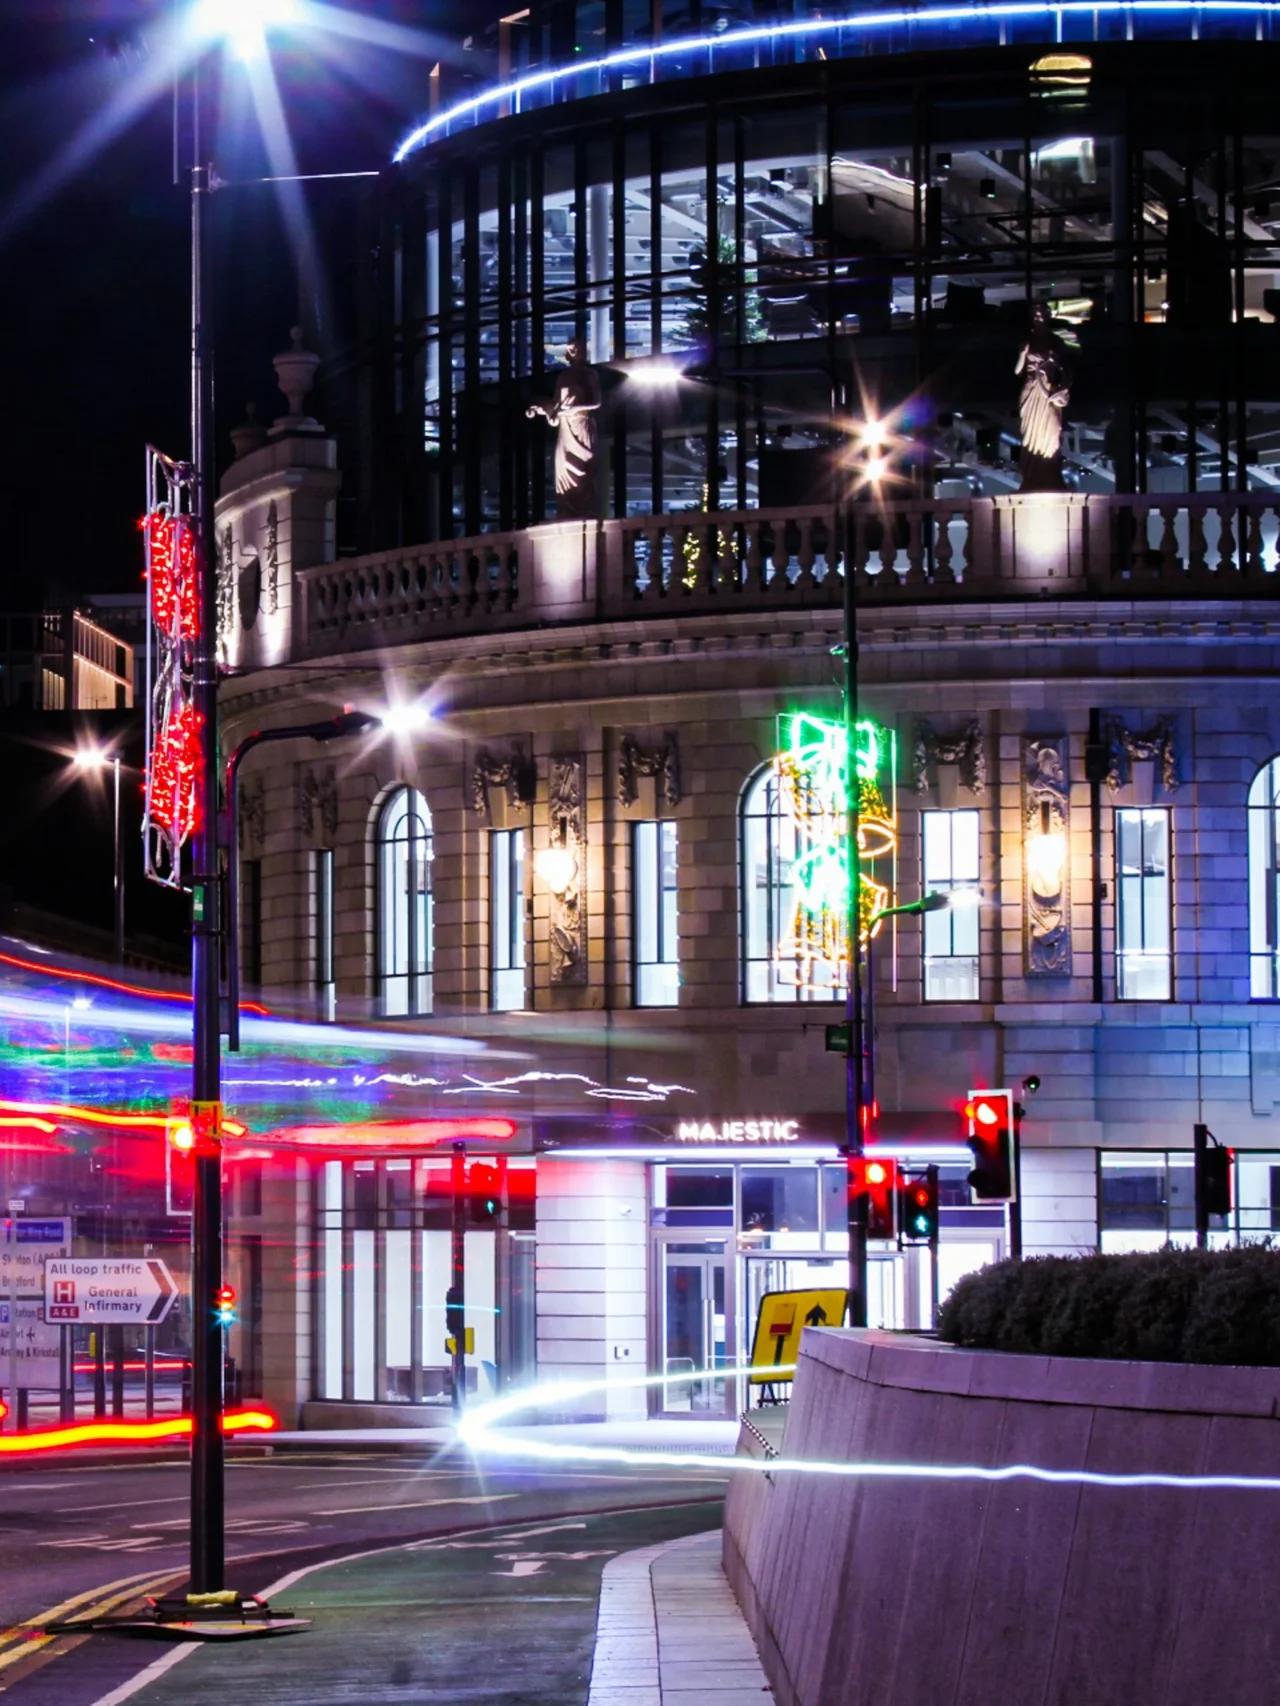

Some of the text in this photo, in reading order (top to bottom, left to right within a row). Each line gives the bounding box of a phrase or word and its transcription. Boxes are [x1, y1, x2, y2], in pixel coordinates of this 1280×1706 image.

[678, 1121, 799, 1141] MAJESTIC
[50, 1263, 142, 1279] All loop traffic
[56, 1282, 73, 1302] H
[88, 1286, 138, 1298] General
[84, 1300, 142, 1314] Infirmary
